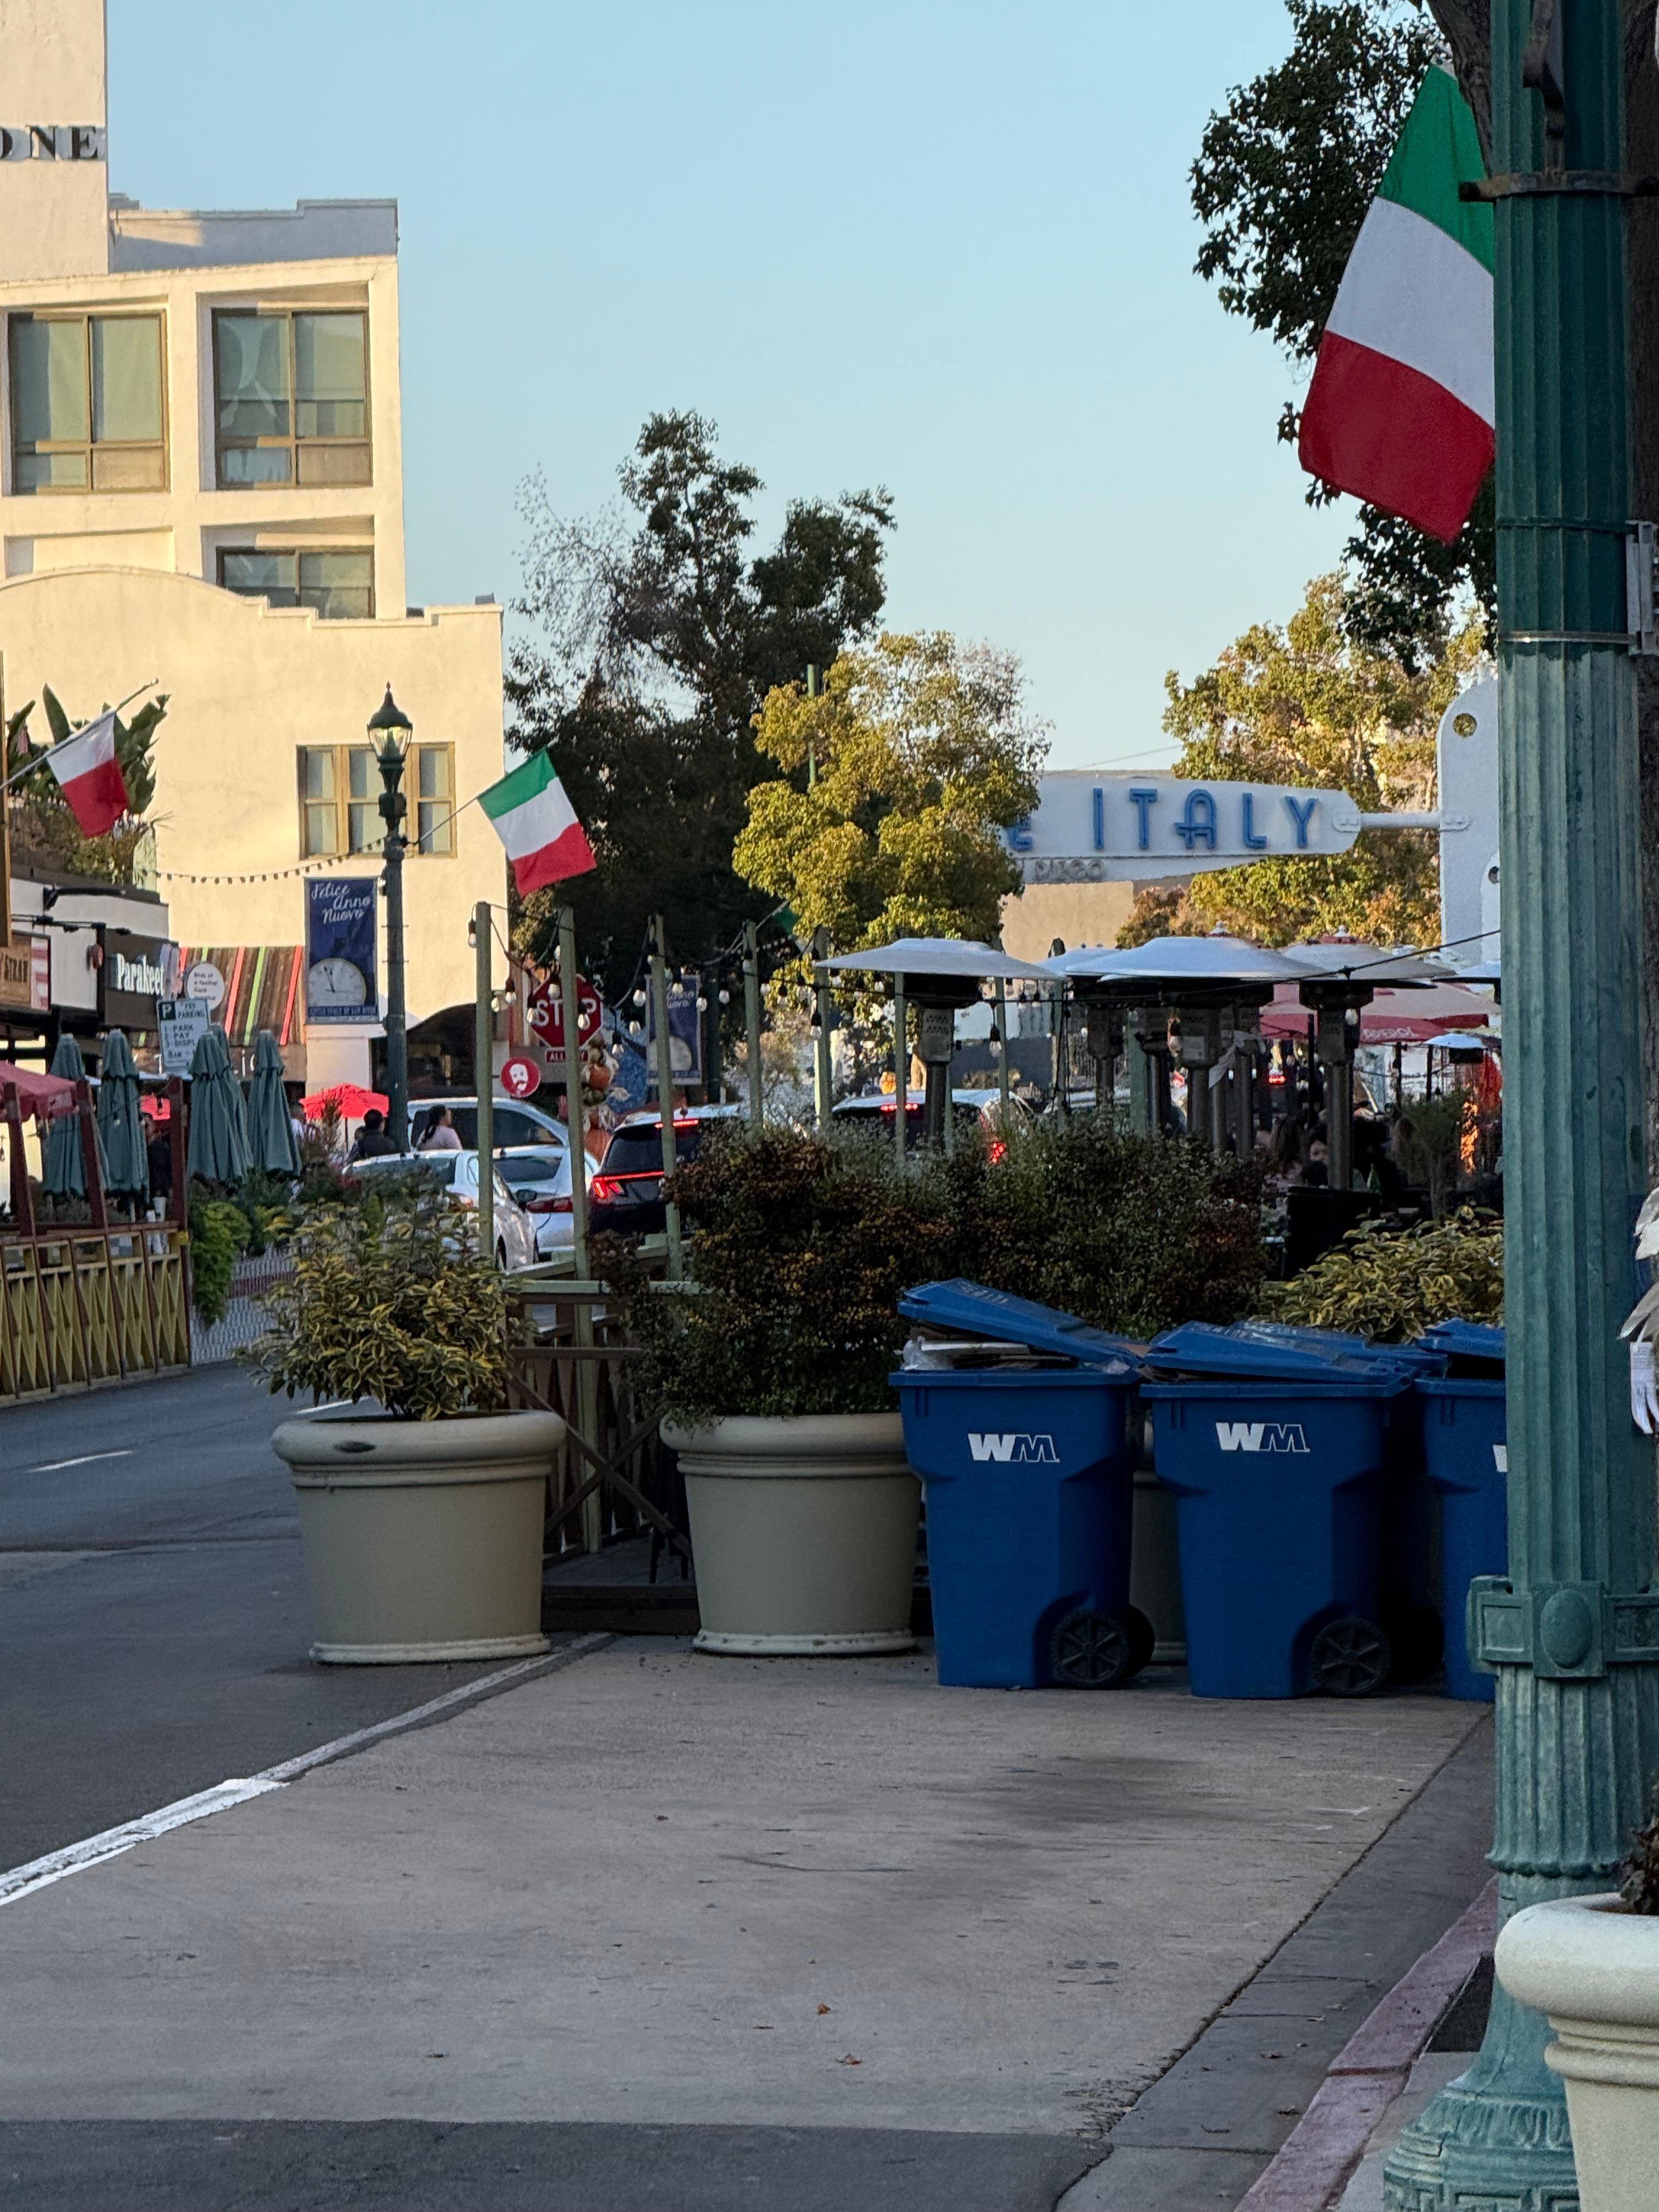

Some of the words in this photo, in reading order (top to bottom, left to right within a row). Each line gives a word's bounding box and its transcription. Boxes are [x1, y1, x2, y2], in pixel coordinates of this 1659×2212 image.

[1092, 787, 1319, 850] ITALY
[311, 882, 350, 900] Felice
[322, 908, 364, 924] Nuovo
[117, 953, 165, 996] Parakeet
[162, 1004, 172, 1019] P
[532, 998, 597, 1026] STP
[967, 1433, 1060, 1463] WM
[1215, 1422, 1310, 1453] WM
